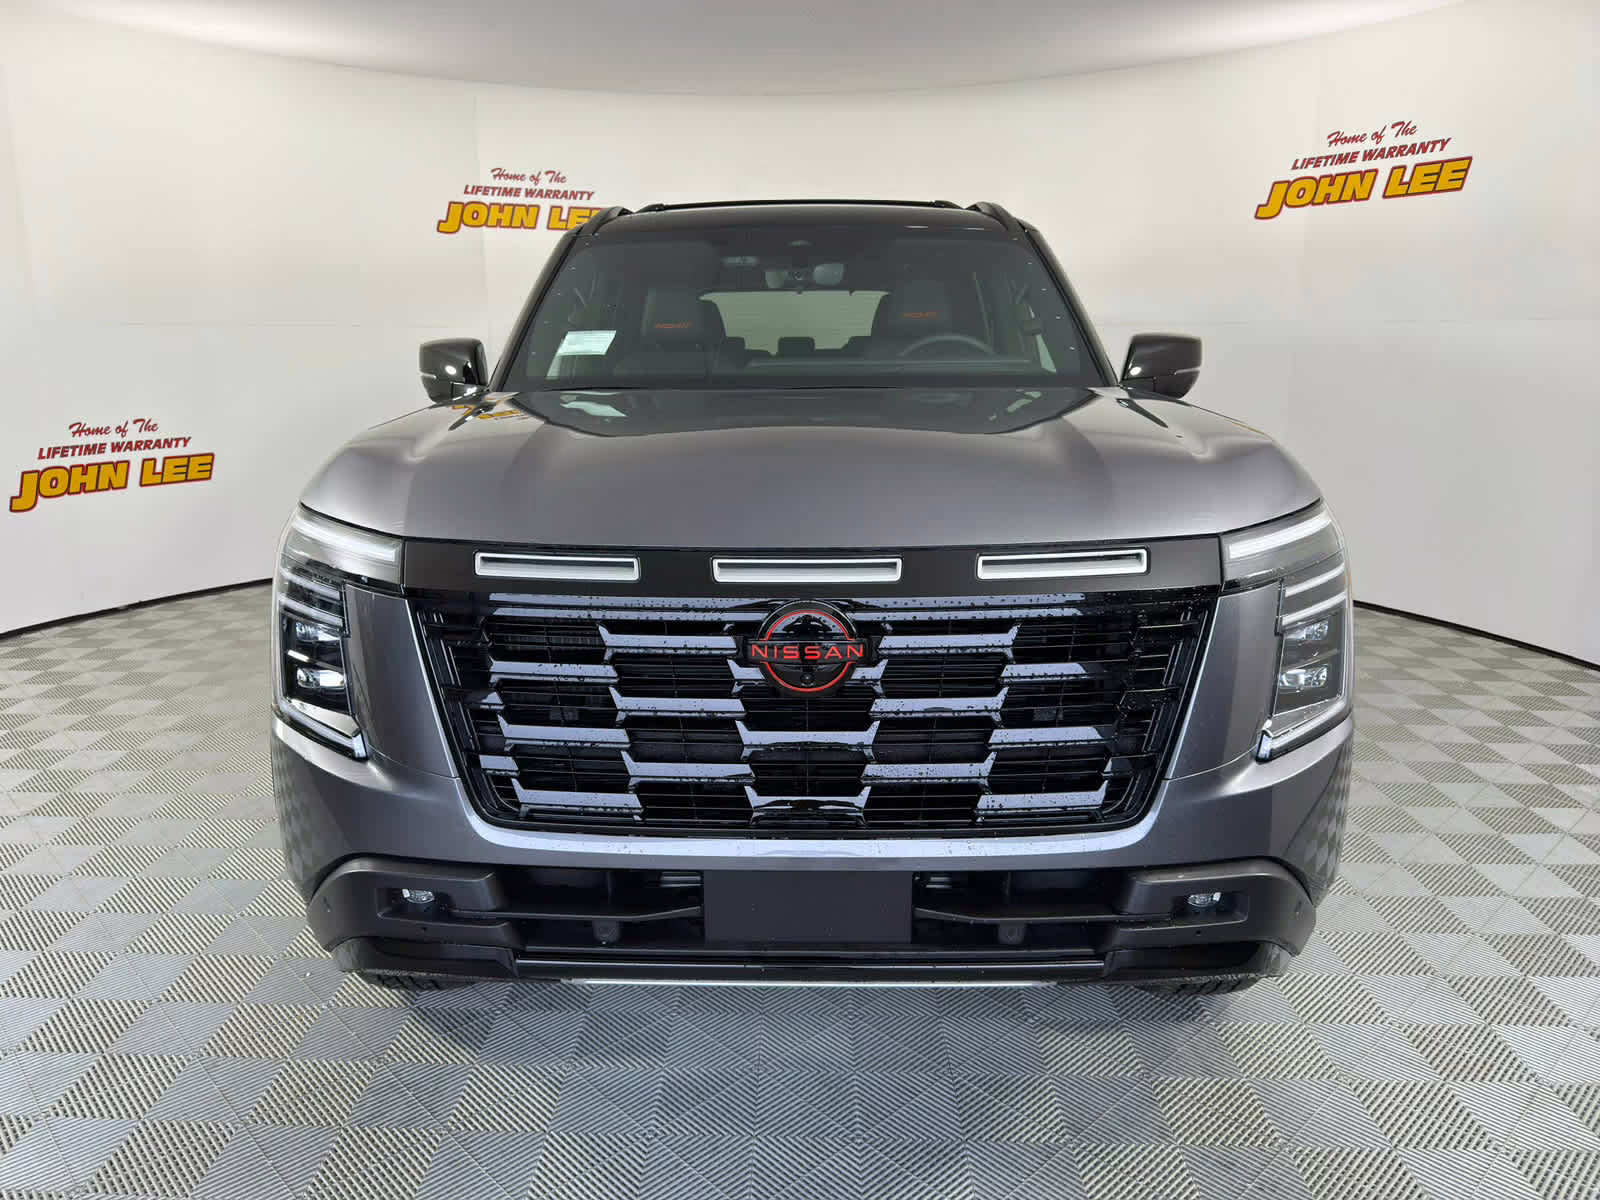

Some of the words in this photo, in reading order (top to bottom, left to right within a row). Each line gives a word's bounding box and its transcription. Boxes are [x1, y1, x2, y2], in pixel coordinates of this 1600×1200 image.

[1327, 131, 1367, 147] Home
[1371, 125, 1387, 144] of
[1391, 120, 1418, 138] The
[1291, 151, 1359, 170] LIFETIME
[1362, 138, 1452, 162] WARRANTY
[490, 167, 526, 182] Home
[529, 172, 541, 185] of
[545, 170, 567, 184] The
[1255, 168, 1379, 220] JOHN
[1382, 156, 1473, 199] LEE
[464, 184, 521, 198] LIFETIME
[524, 188, 595, 200] WARRANTY
[437, 201, 540, 234] JOHN
[547, 206, 604, 231] LE
[69, 422, 111, 437] Home
[115, 420, 128, 437] of
[133, 418, 159, 433] The
[38, 443, 107, 460] LIFETIME
[110, 436, 192, 453] WARRANTY
[9, 460, 130, 512] JOHN
[139, 453, 215, 487] LEE
[751, 644, 865, 660] NISSAN
